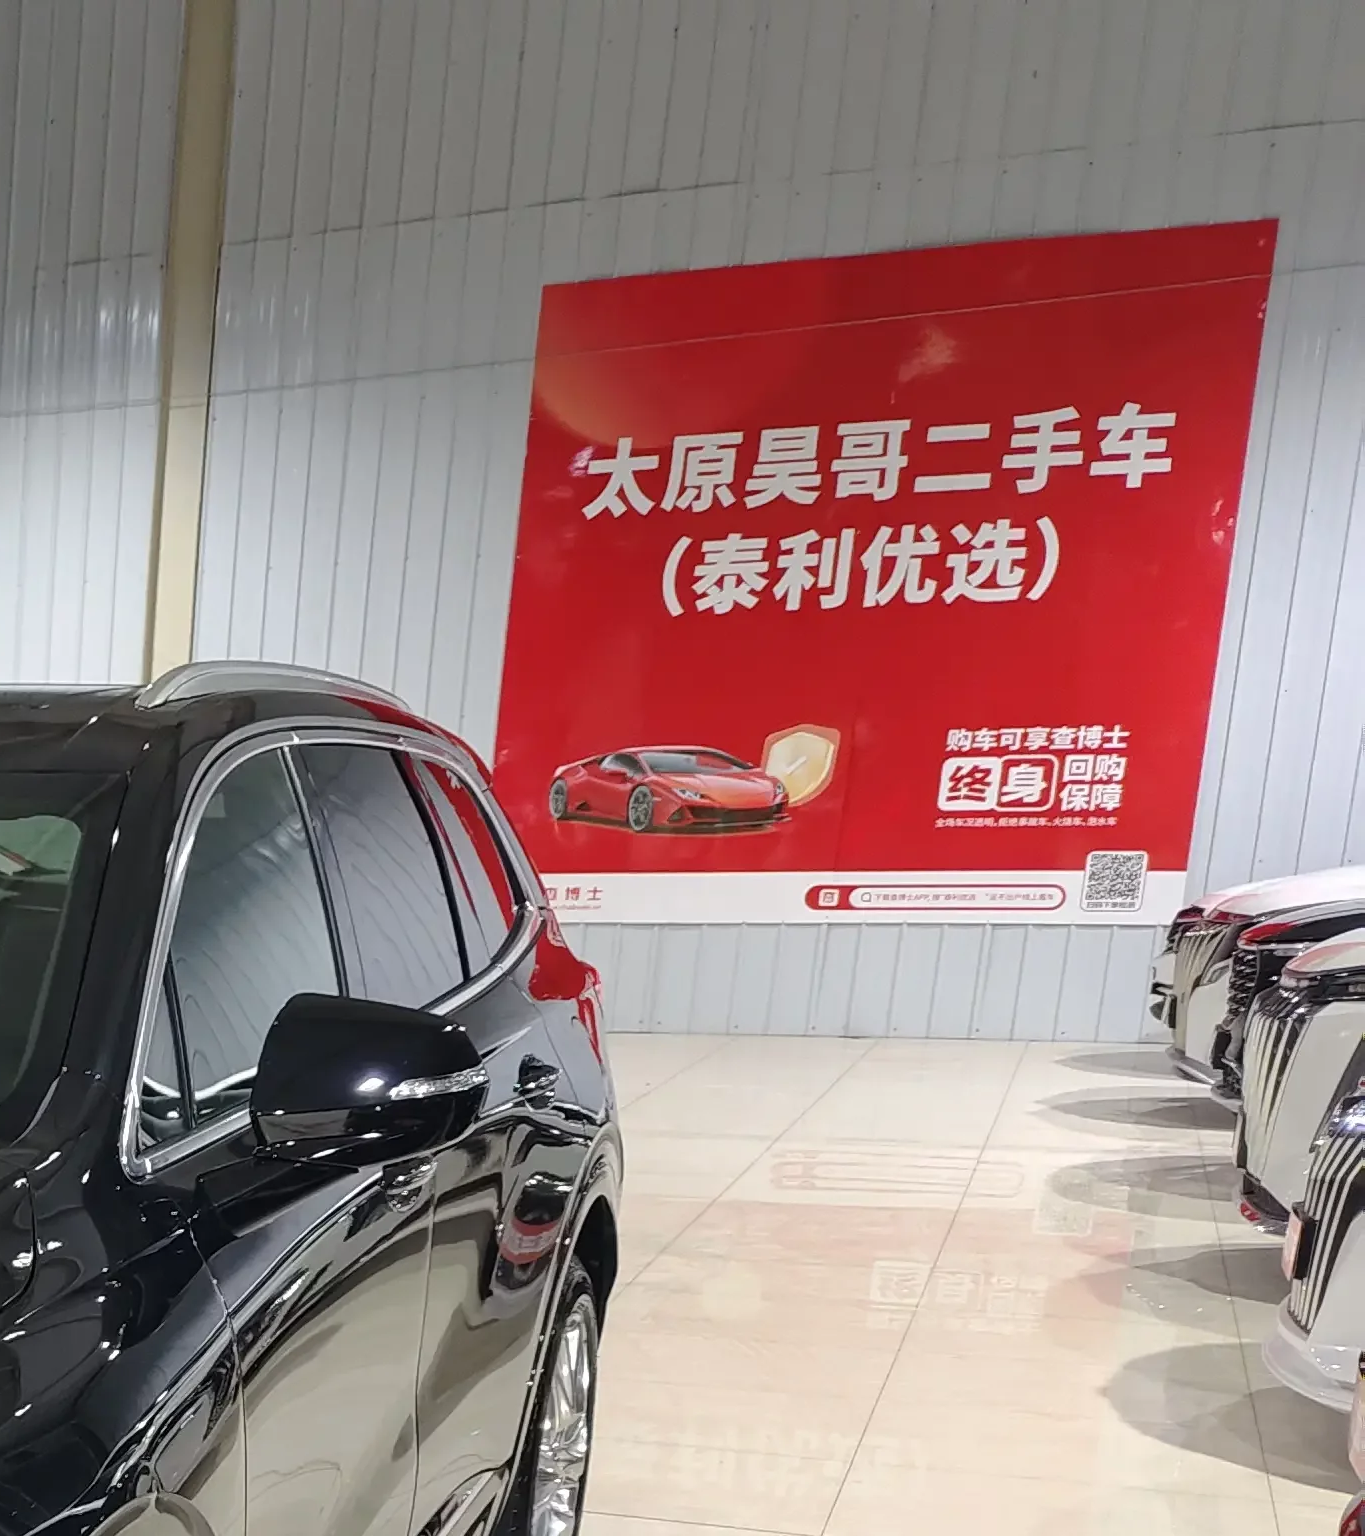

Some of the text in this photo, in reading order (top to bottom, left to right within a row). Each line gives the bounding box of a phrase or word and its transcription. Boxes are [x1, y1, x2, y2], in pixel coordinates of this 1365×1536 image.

[581, 401, 1179, 520] 太原昊哥二手车
[946, 726, 1131, 752] 购车可享查博士
[1062, 754, 1127, 782] 回购
[944, 763, 1049, 804] 终身
[1059, 783, 1124, 812] 保障
